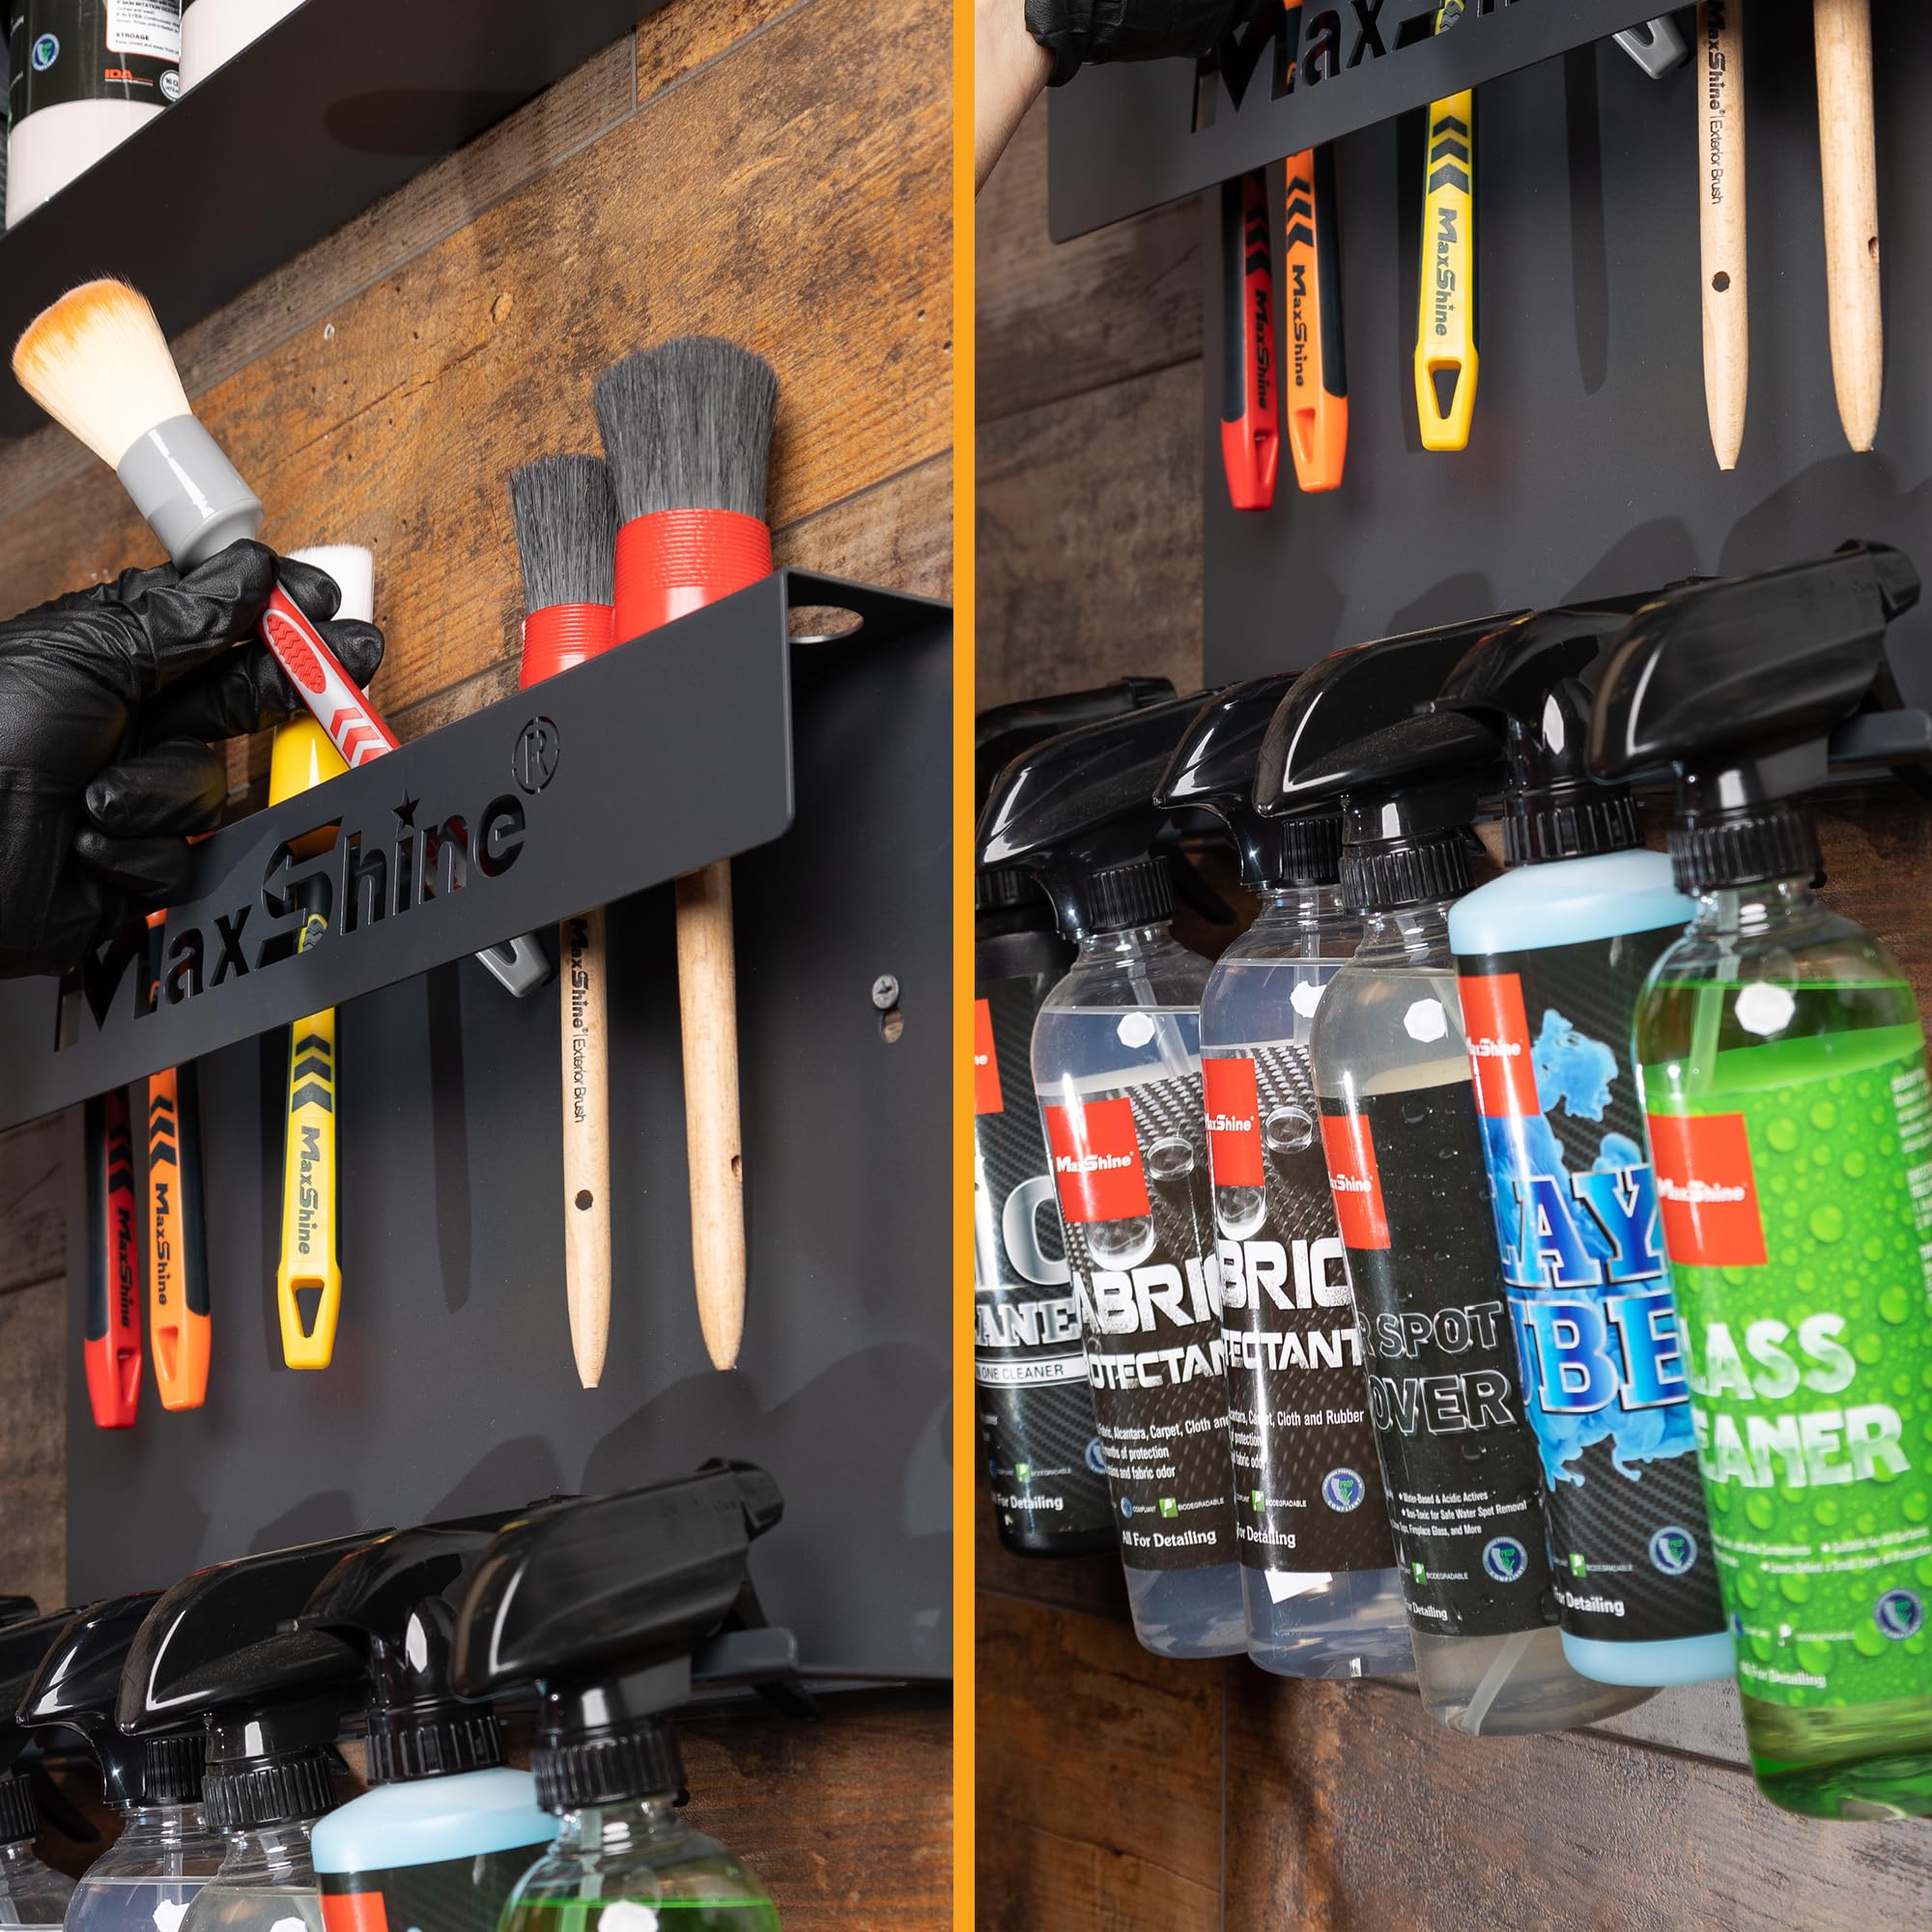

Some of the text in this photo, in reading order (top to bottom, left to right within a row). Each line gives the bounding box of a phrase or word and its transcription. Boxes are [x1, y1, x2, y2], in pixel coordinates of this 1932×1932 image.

[104, 69, 132, 80] IDA
[1709, 120, 1722, 166] Exterior
[1711, 169, 1723, 205] Brush
[1437, 208, 1458, 336] MaxShine
[1292, 265, 1308, 387] MaxShine
[1254, 289, 1271, 409] MaxShine
[573, 1037, 586, 1085] Exterior
[574, 1087, 587, 1123] Brush
[298, 1125, 319, 1255] MaxShine
[155, 1183, 172, 1305] MaxShine
[118, 1207, 135, 1328] MaxShine
[1377, 1300, 1504, 1359] SPOT
[1002, 1363, 1064, 1381] CLEANER
[1150, 1423, 1184, 1440] Carpet,
[1184, 1416, 1211, 1435] Cloth
[1277, 1410, 1301, 1427] Cloth
[1304, 1410, 1323, 1427] and
[1325, 1408, 1365, 1426] Rubber
[1129, 1446, 1170, 1463] protection
[1131, 1465, 1154, 1480] fabric
[1155, 1463, 1176, 1479] odor
[1009, 1494, 1064, 1511] Detailing
[1430, 1508, 1439, 1520] for
[1439, 1508, 1456, 1520] Safe
[1455, 1507, 1477, 1520] Water
[1477, 1505, 1495, 1519] Spot
[1495, 1499, 1527, 1516] Removal
[1441, 1492, 1463, 1504] Acidic
[1463, 1491, 1489, 1503] Actives
[1133, 1532, 1151, 1548] For
[1152, 1530, 1217, 1548] Detailing
[1246, 1526, 1296, 1548] Detailing
[1431, 1524, 1450, 1537] Glass,
[1450, 1524, 1463, 1536] and
[1463, 1523, 1483, 1535] More
[1412, 1602, 1448, 1621] Detailing
[1565, 1591, 1625, 1617] Detailing
